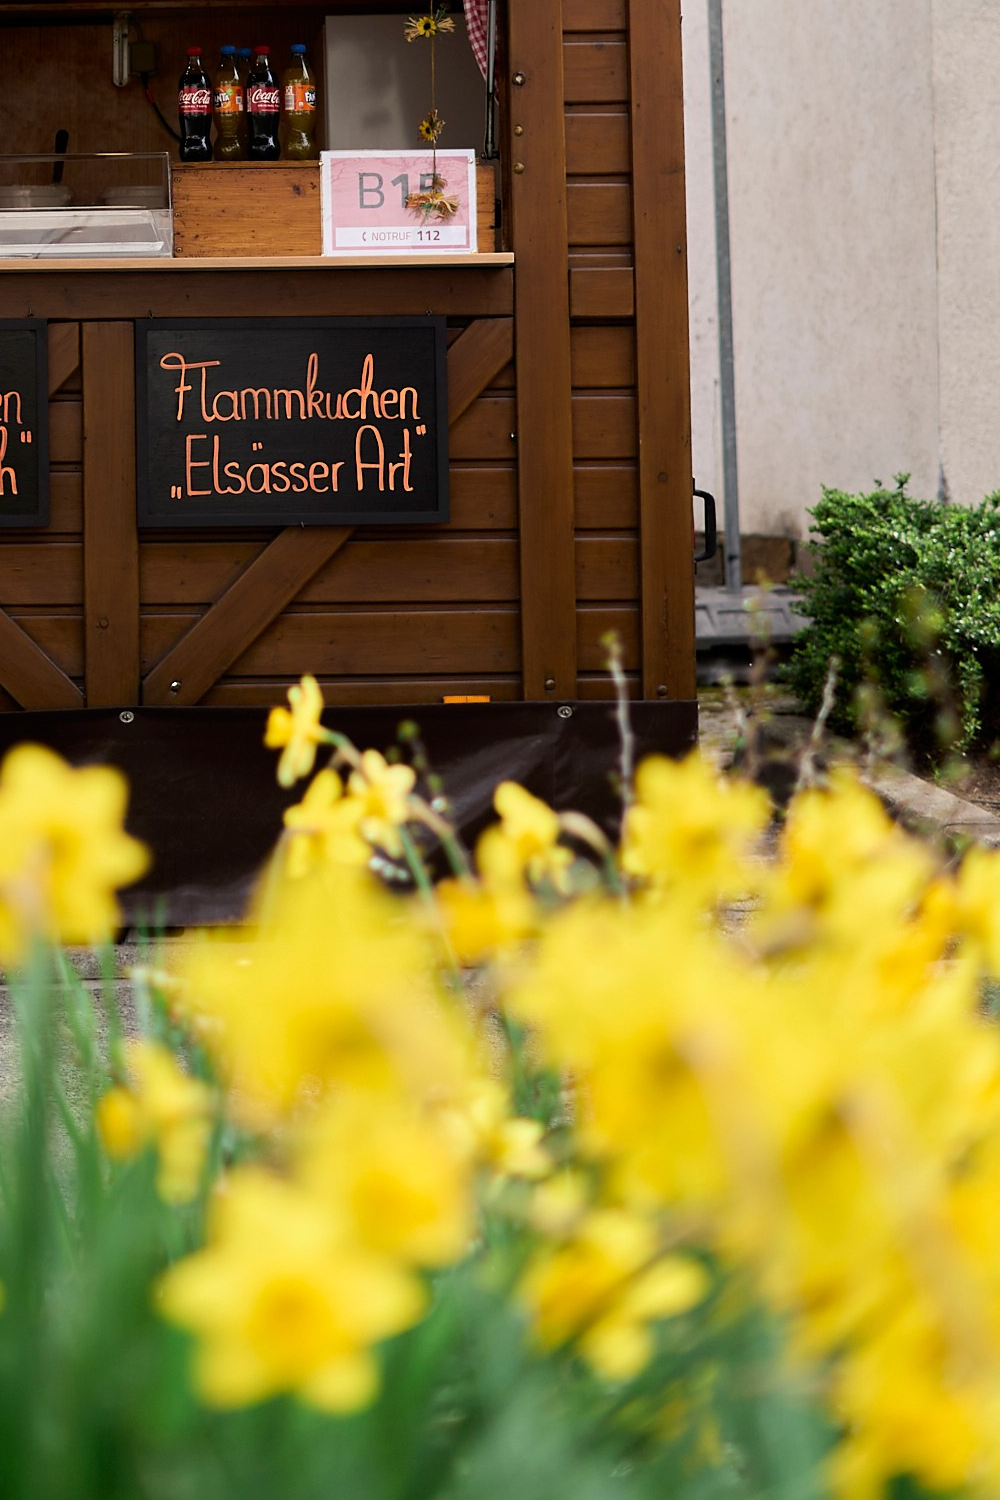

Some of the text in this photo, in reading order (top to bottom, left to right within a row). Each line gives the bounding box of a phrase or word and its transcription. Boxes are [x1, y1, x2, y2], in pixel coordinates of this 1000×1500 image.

[371, 230, 441, 242] NOTRUF 112
[160, 352, 422, 422] Flammkuchen
